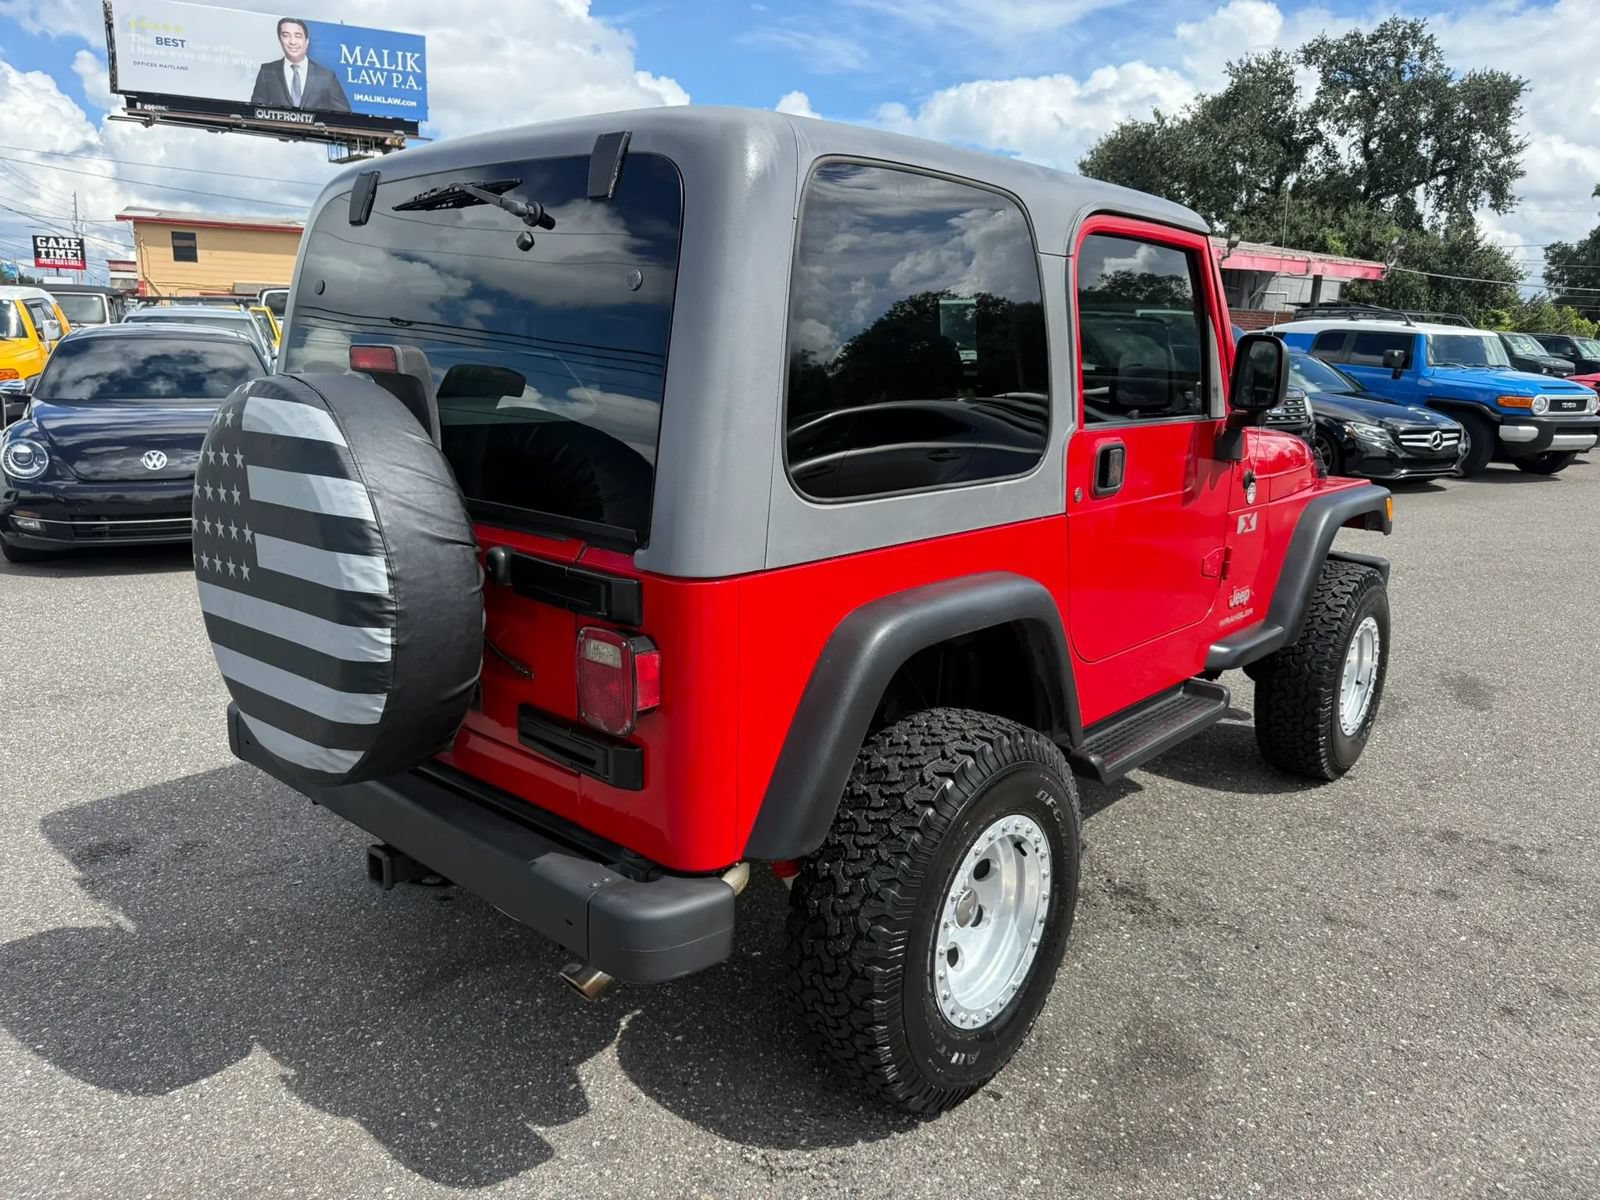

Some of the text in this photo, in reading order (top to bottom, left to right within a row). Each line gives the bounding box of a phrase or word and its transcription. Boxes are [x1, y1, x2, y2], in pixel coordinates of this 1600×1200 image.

[155, 36, 187, 49] BEST
[339, 43, 422, 73] MALIK
[346, 66, 423, 91] LAW P.A.
[36, 237, 81, 249] GAME
[38, 248, 81, 260] TIME!
[1228, 587, 1251, 608] Jeep
